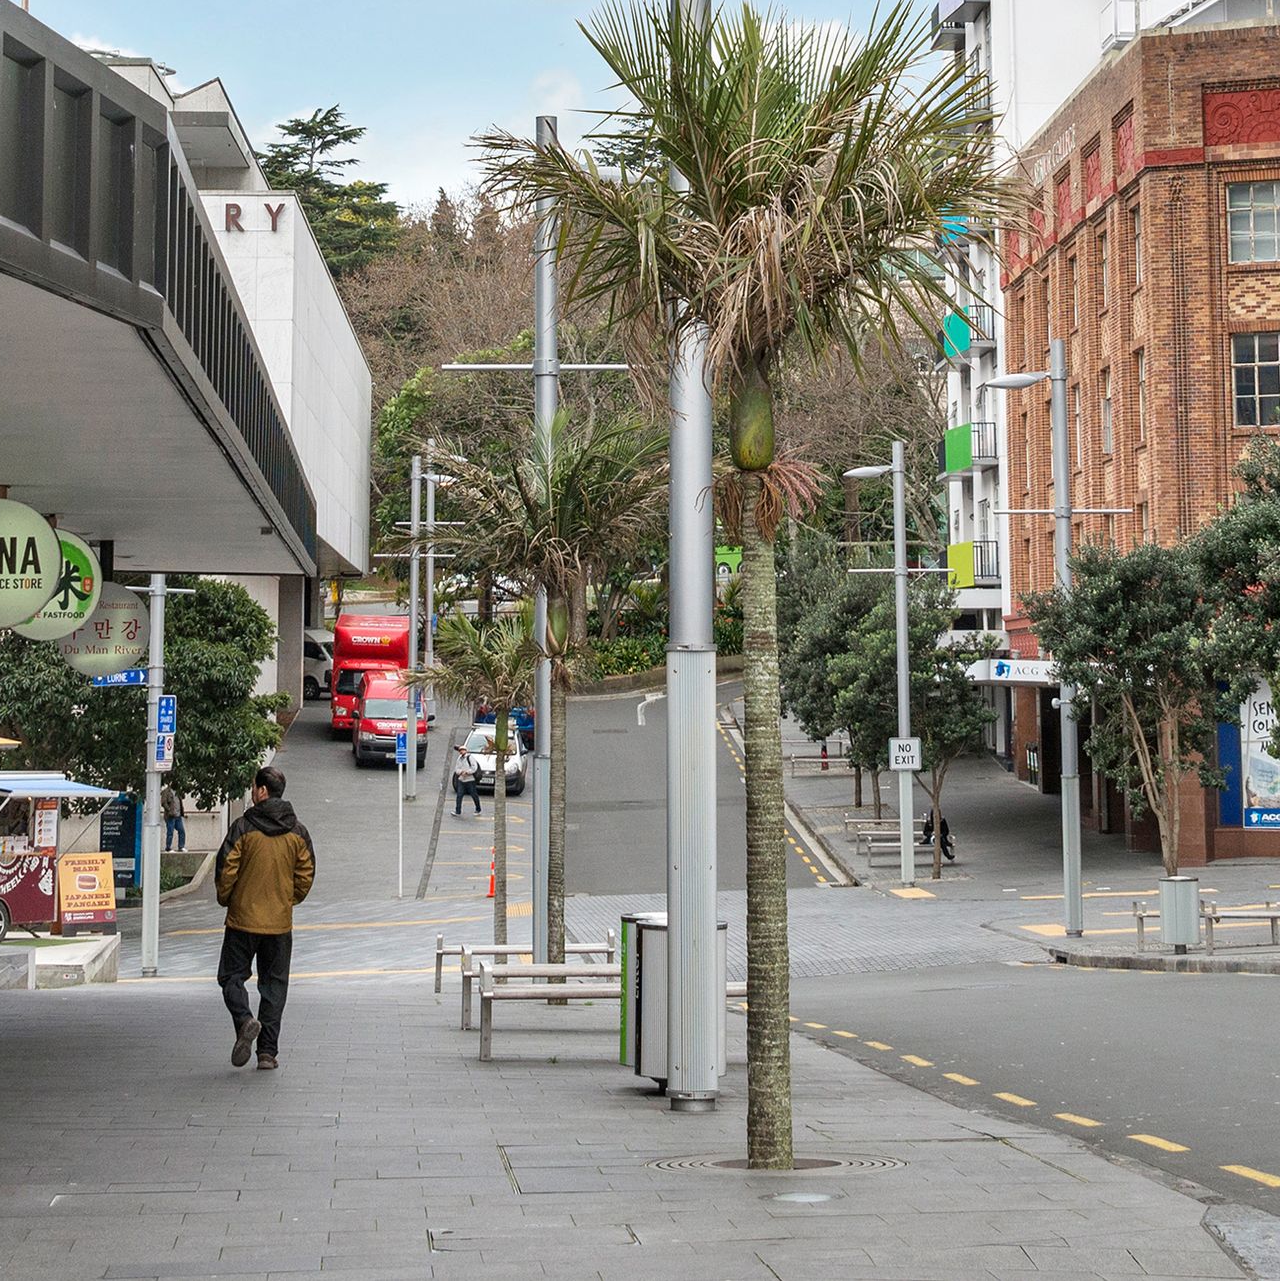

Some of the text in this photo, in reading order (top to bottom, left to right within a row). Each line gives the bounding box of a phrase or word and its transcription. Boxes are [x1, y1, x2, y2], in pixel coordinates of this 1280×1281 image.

[13, 578, 42, 589] STORE
[99, 600, 139, 610] Restaurant
[43, 611, 85, 619] FASTFOOD
[64, 644, 142, 655] Du Man River
[1014, 667, 1039, 675] ACG
[898, 743, 912, 753] NO
[895, 755, 915, 764] EXIT
